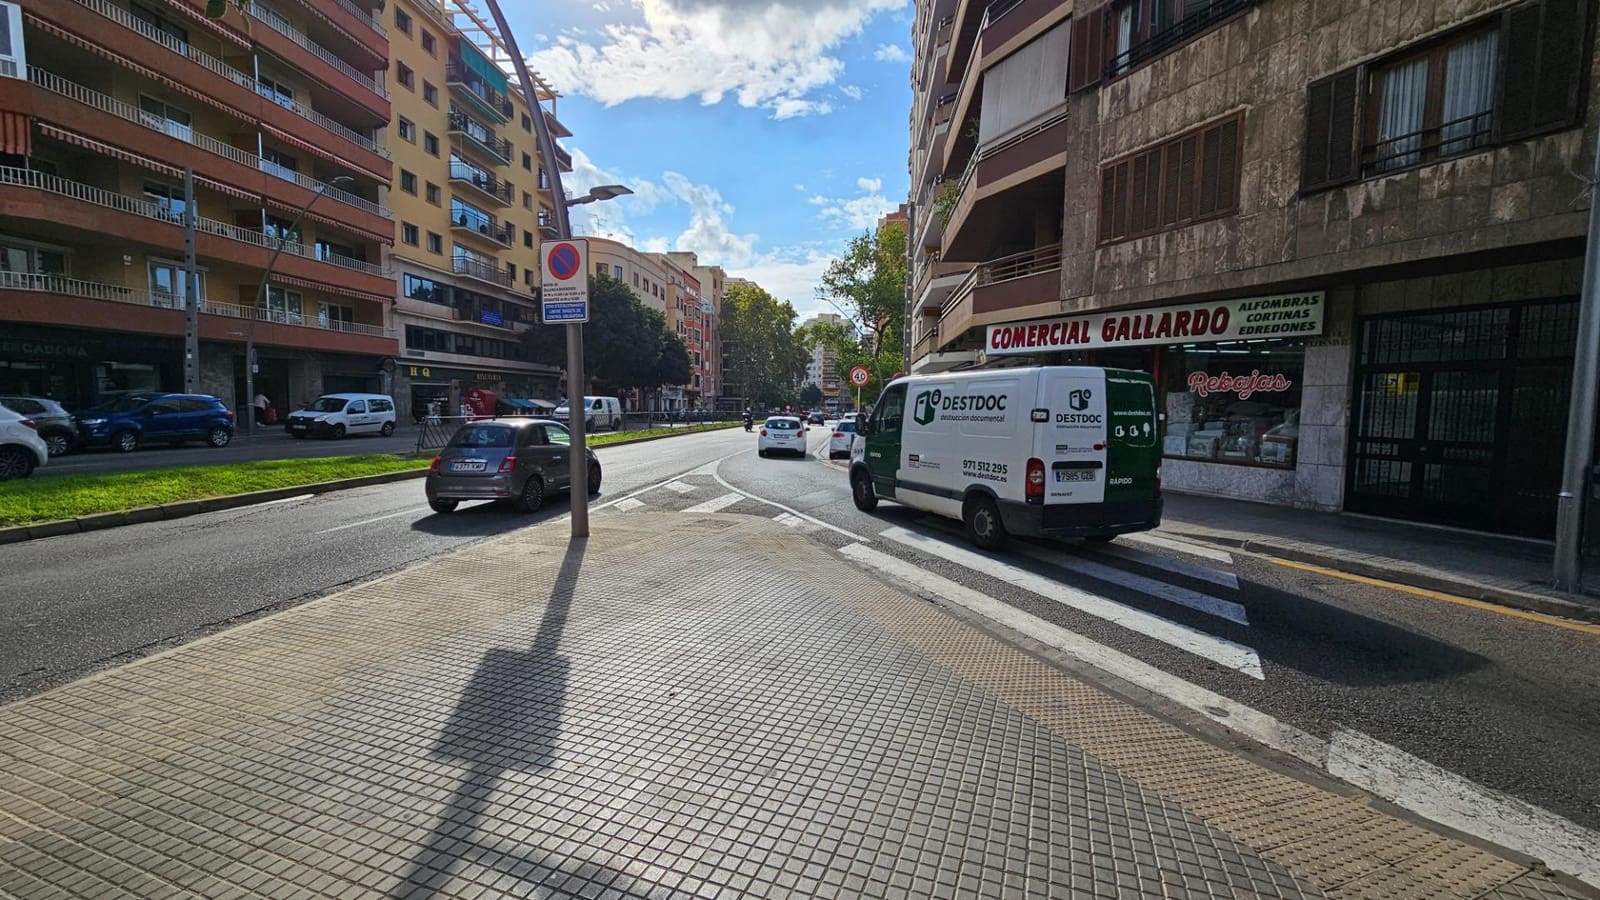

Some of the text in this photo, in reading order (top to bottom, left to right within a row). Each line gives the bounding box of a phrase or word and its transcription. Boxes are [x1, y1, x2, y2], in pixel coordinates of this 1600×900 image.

[1238, 295, 1320, 312] ALFOMBRAS
[1246, 309, 1310, 322] CORTINAS
[991, 305, 1231, 350] COMERCIAL GALLARDO
[1238, 321, 1317, 335] EDREDONES
[409, 367, 431, 377] H Q
[1187, 369, 1292, 400] Rebajas
[942, 395, 1007, 411] DESTDOC
[1055, 413, 1102, 424] DESTDOC
[963, 460, 1008, 474] 971 512 295
